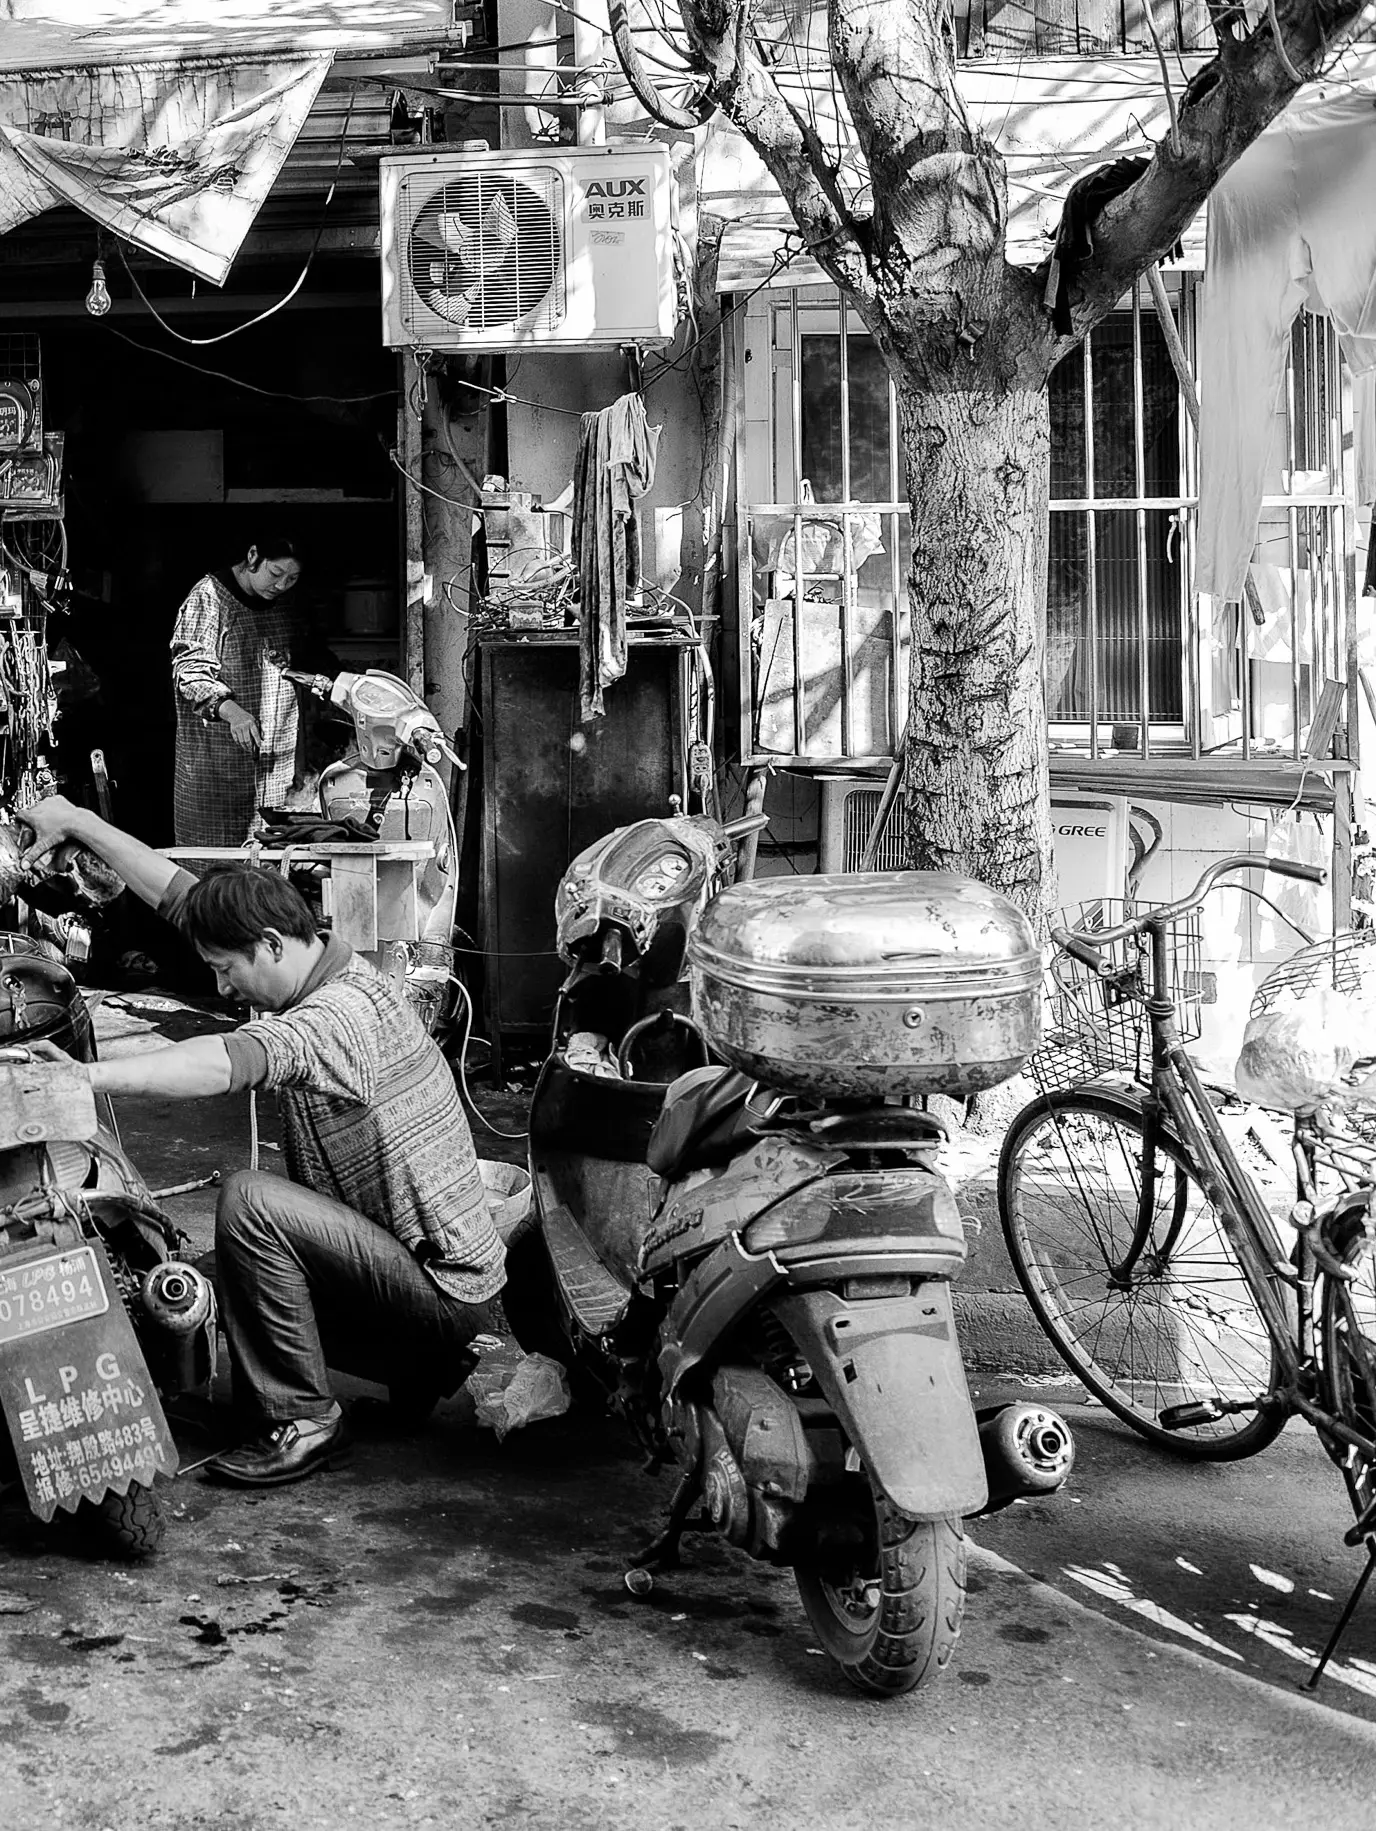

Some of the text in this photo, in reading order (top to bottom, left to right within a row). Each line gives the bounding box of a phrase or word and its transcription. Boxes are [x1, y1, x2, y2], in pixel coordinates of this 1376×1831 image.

[585, 179, 646, 199] AUX
[588, 200, 644, 219] 奥克斯
[1058, 825, 1107, 837] GREE
